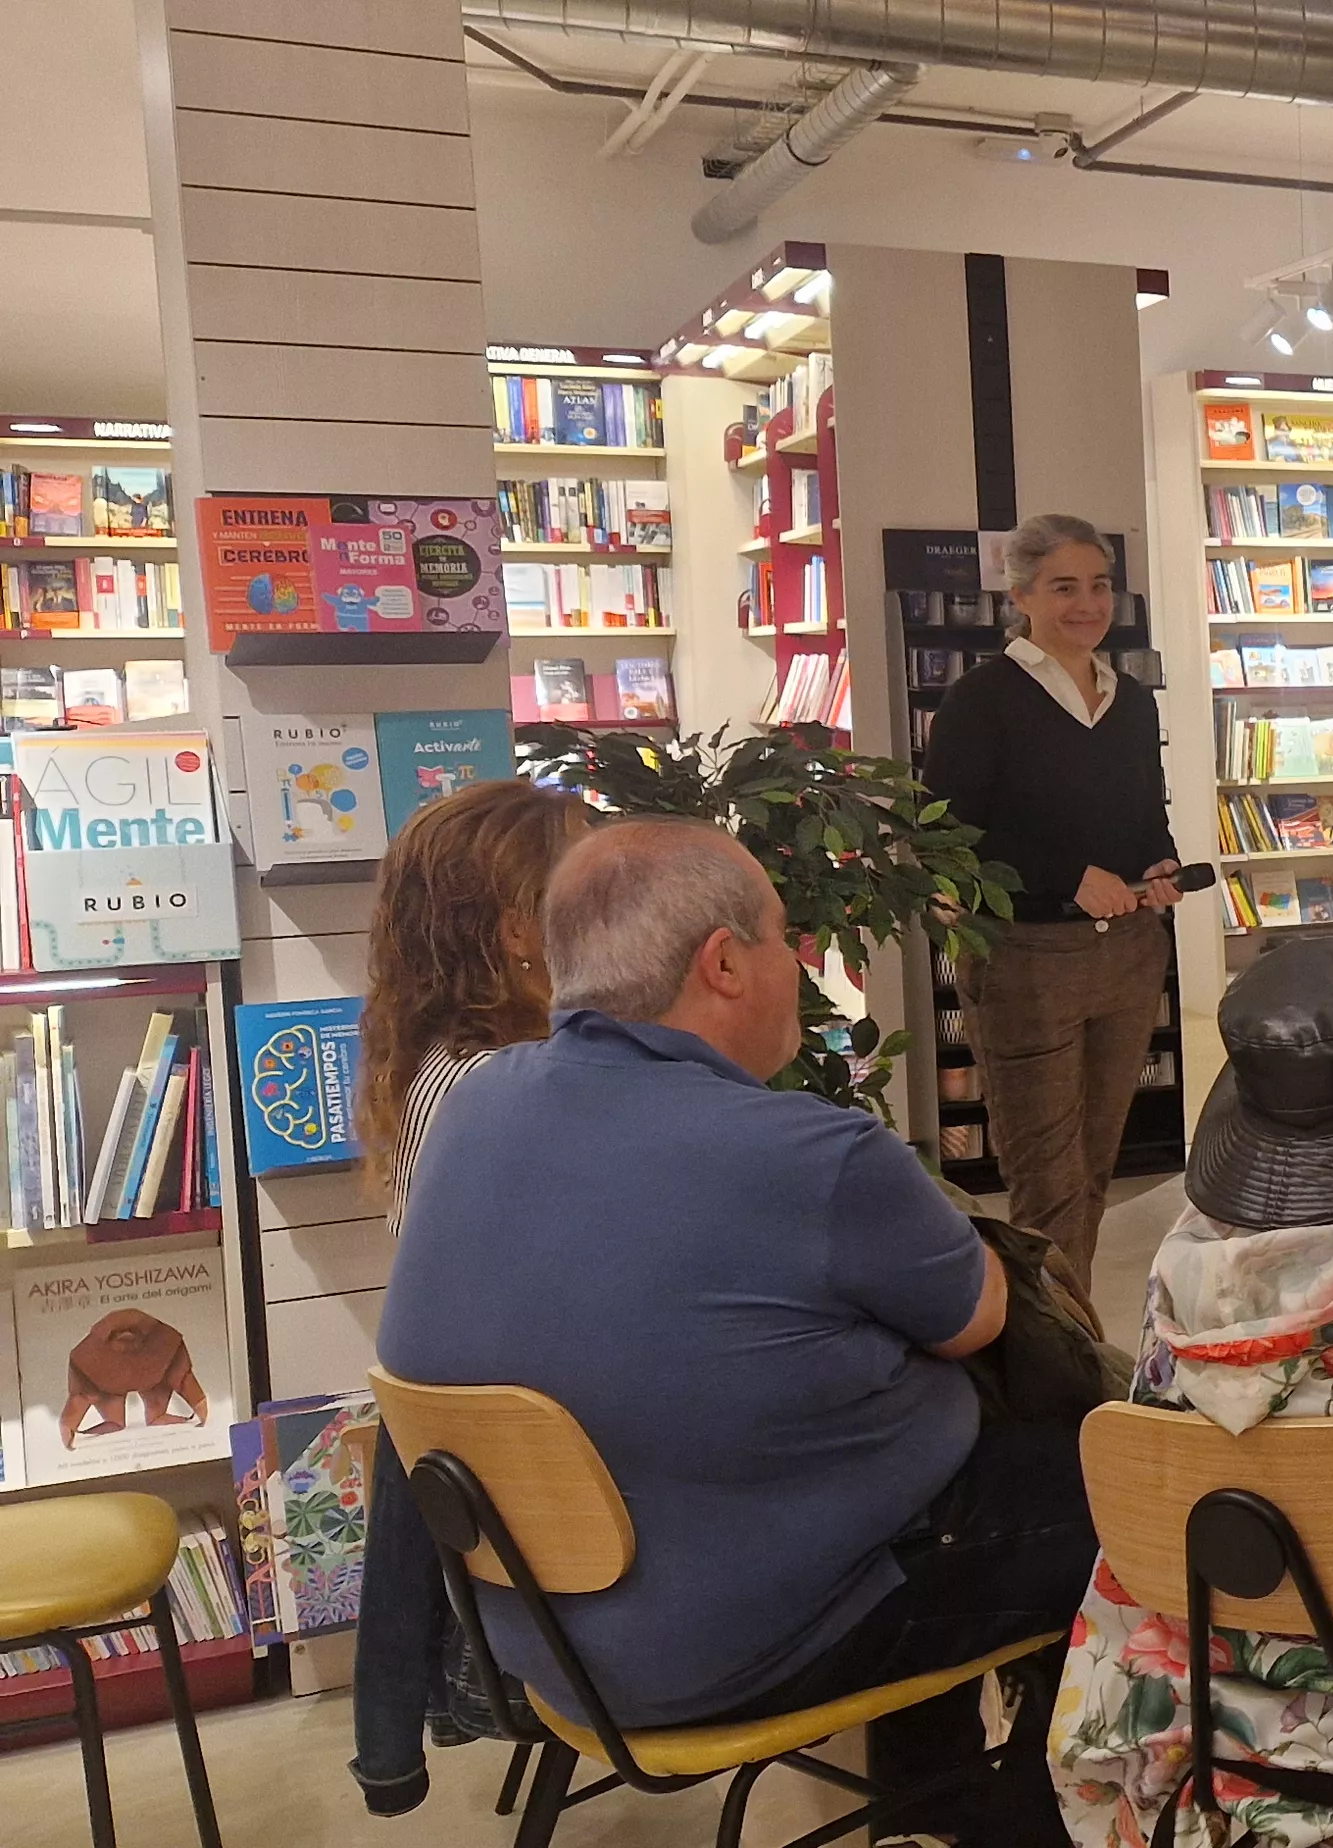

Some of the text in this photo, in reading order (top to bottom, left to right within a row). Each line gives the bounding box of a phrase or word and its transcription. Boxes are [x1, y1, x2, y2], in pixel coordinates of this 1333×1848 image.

[520, 348, 576, 363] GENERAL
[94, 422, 174, 438] NARRATIVA
[222, 509, 309, 527] ENTRENA
[382, 531, 403, 541] 50
[320, 538, 376, 552] Mente
[926, 545, 977, 556] DRAEGER
[420, 562, 469, 574] MEMORIA
[288, 622, 318, 630] FORM
[273, 728, 341, 740] RUBIO
[414, 737, 482, 753] Activarte
[33, 745, 202, 806] ÁGIL
[34, 807, 205, 850] Mente
[84, 893, 187, 912] RUBIO
[321, 1041, 346, 1143] PASATIEMPOS
[28, 1263, 210, 1298] AKIRA YOSHIZAWA
[100, 1282, 212, 1304] El arte del origami
